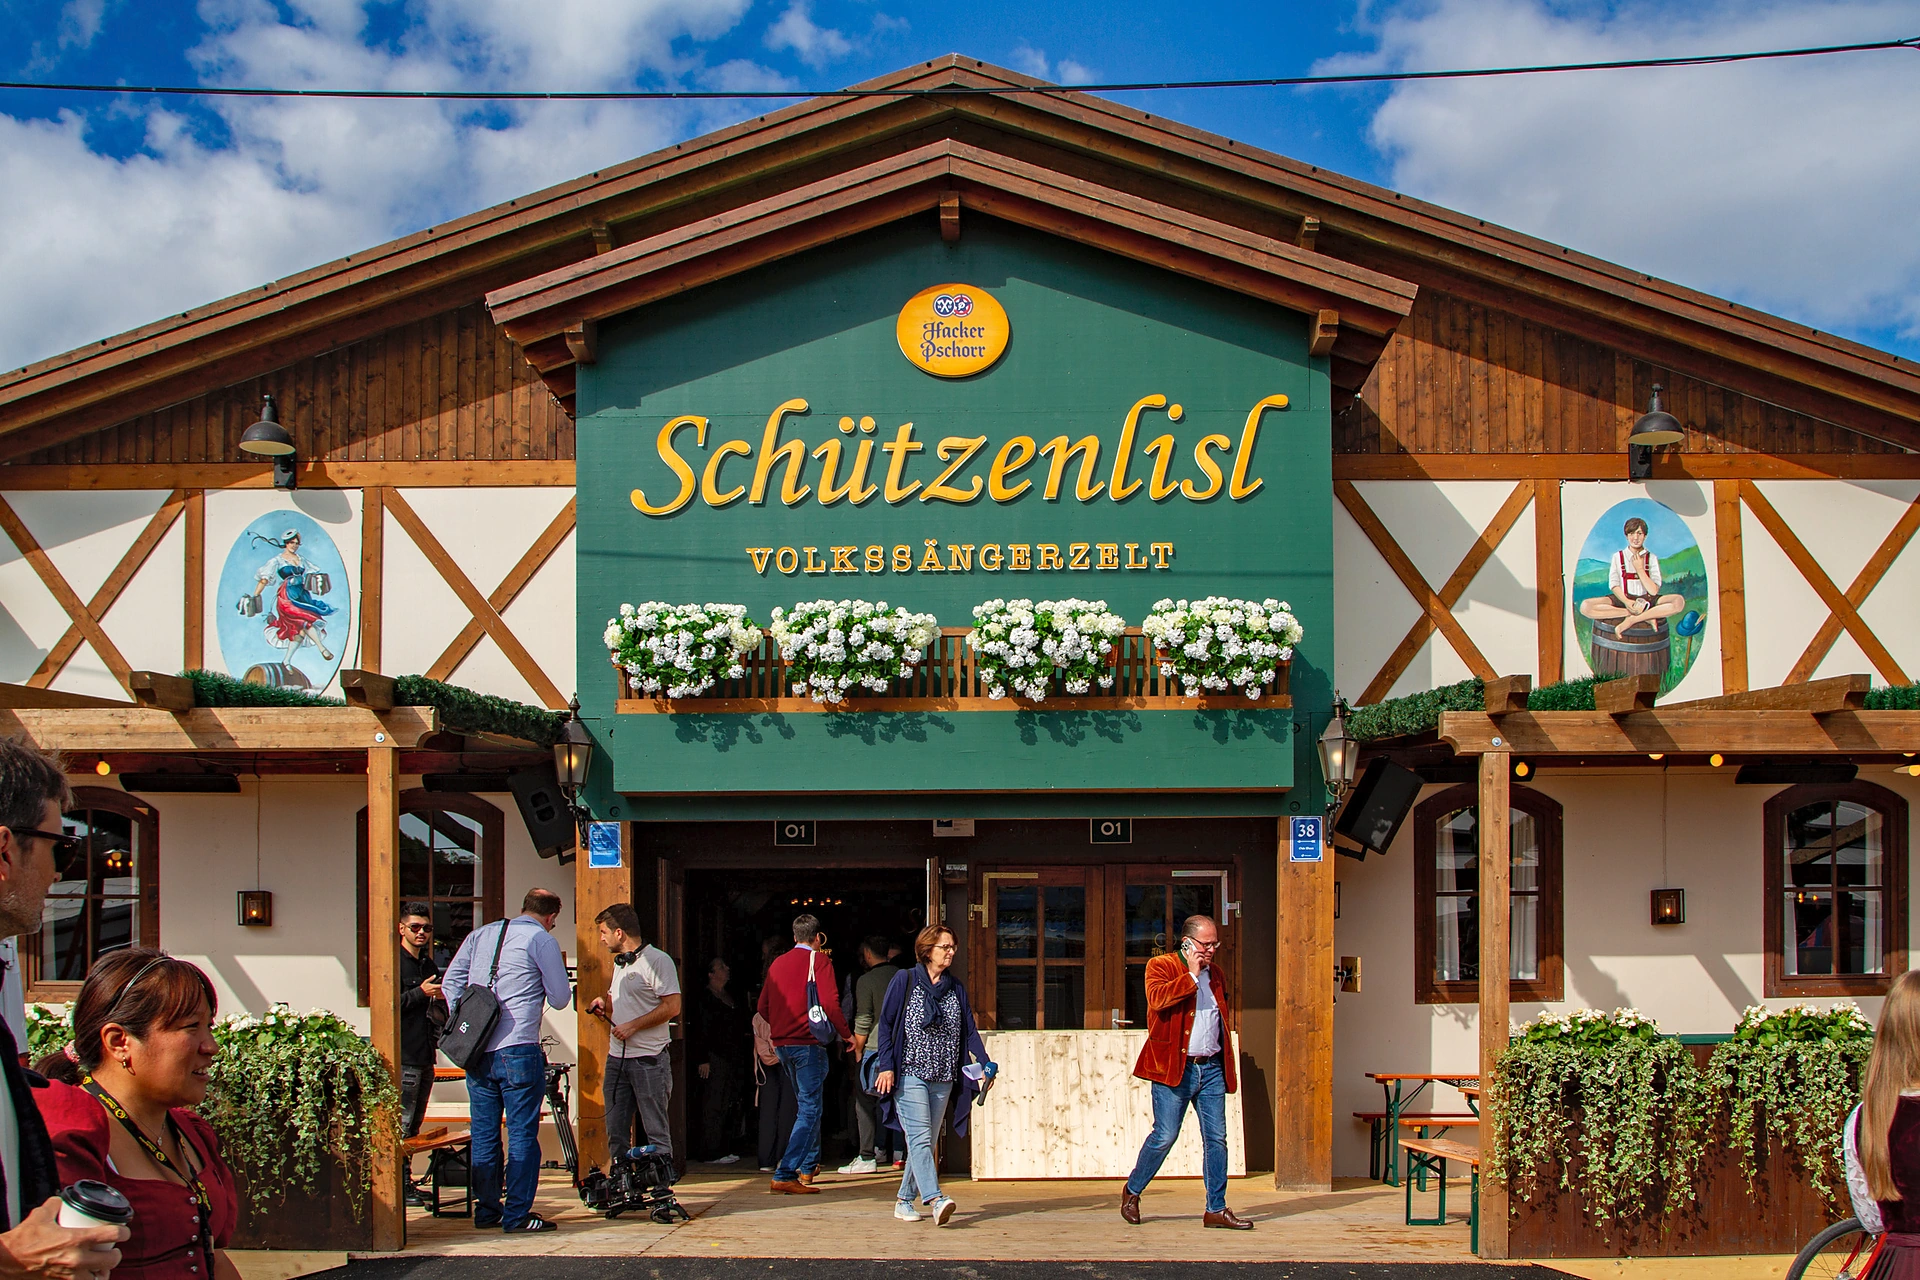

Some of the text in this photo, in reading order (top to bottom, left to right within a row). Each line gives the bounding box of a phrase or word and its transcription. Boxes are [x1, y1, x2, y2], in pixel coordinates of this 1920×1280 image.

[923, 321, 985, 341] Hacker
[920, 340, 985, 363] Pschorr
[630, 393, 1289, 516] Schützenlisl
[746, 539, 1174, 574] VOLKSSÄNGERZELT
[785, 824, 805, 838] 01
[1101, 821, 1121, 836] 01
[1297, 824, 1315, 838] 38
[459, 1021, 470, 1034] BR
